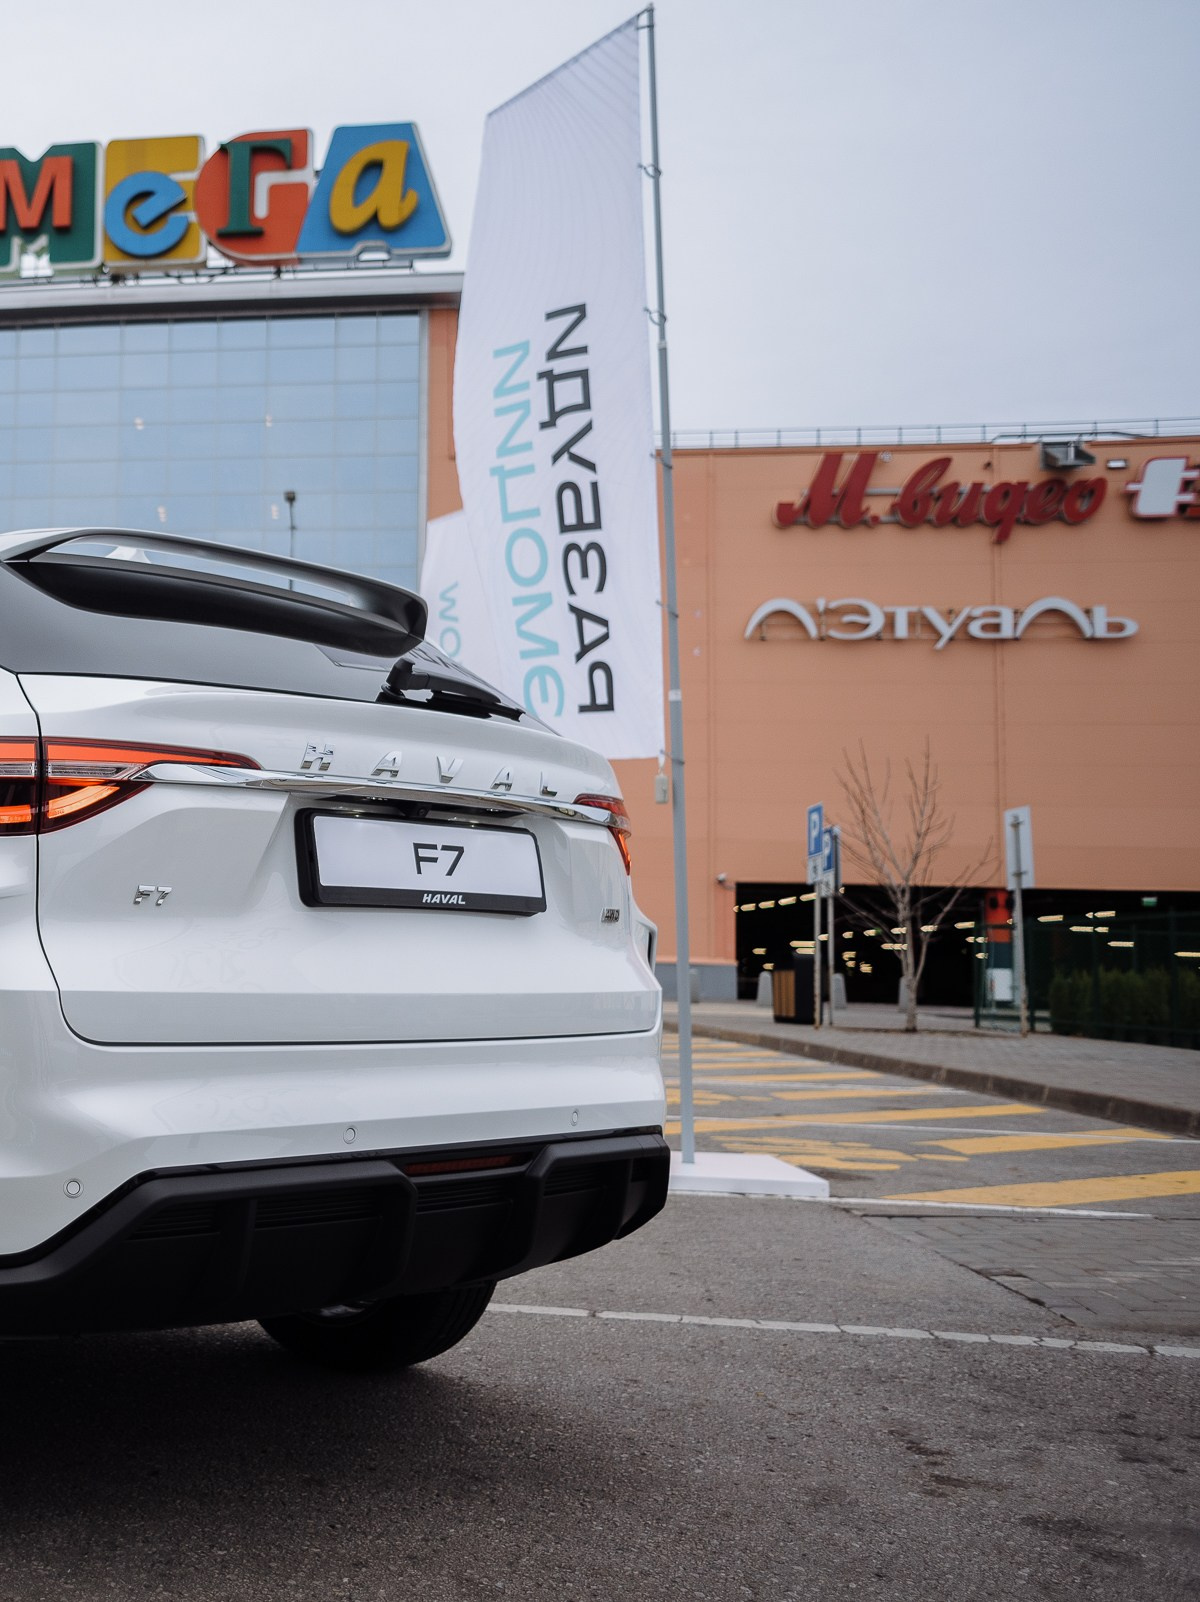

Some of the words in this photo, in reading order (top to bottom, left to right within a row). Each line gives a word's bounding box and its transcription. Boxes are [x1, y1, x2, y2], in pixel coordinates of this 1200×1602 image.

[300, 741, 559, 798] HAVAL
[412, 842, 465, 877] F7
[133, 885, 172, 906] F7
[422, 893, 467, 905] HAVAL
